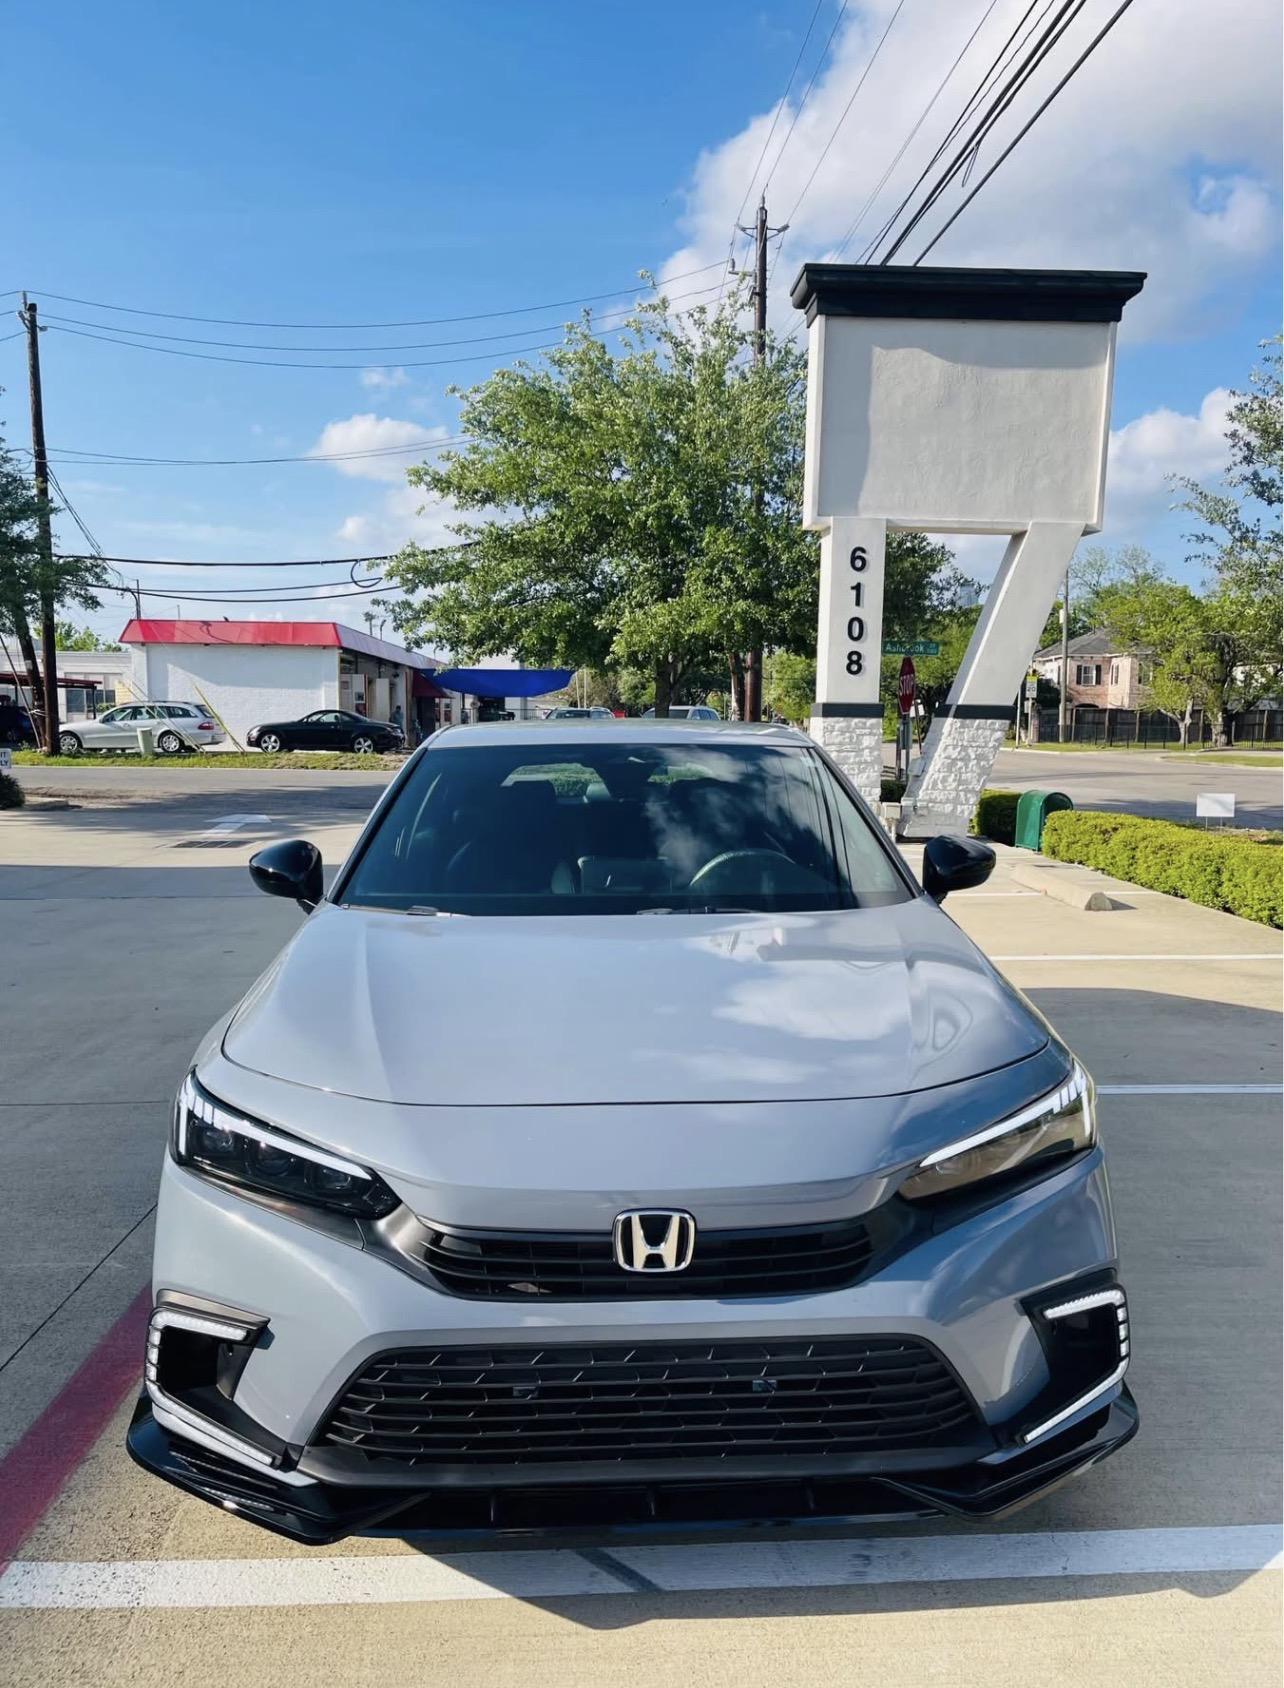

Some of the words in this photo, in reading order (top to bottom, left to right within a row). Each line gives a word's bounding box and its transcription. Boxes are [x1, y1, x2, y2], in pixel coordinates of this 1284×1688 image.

[846, 546, 867, 676] 6108
[886, 642, 925, 654] Ashok
[899, 674, 915, 696] STOP
